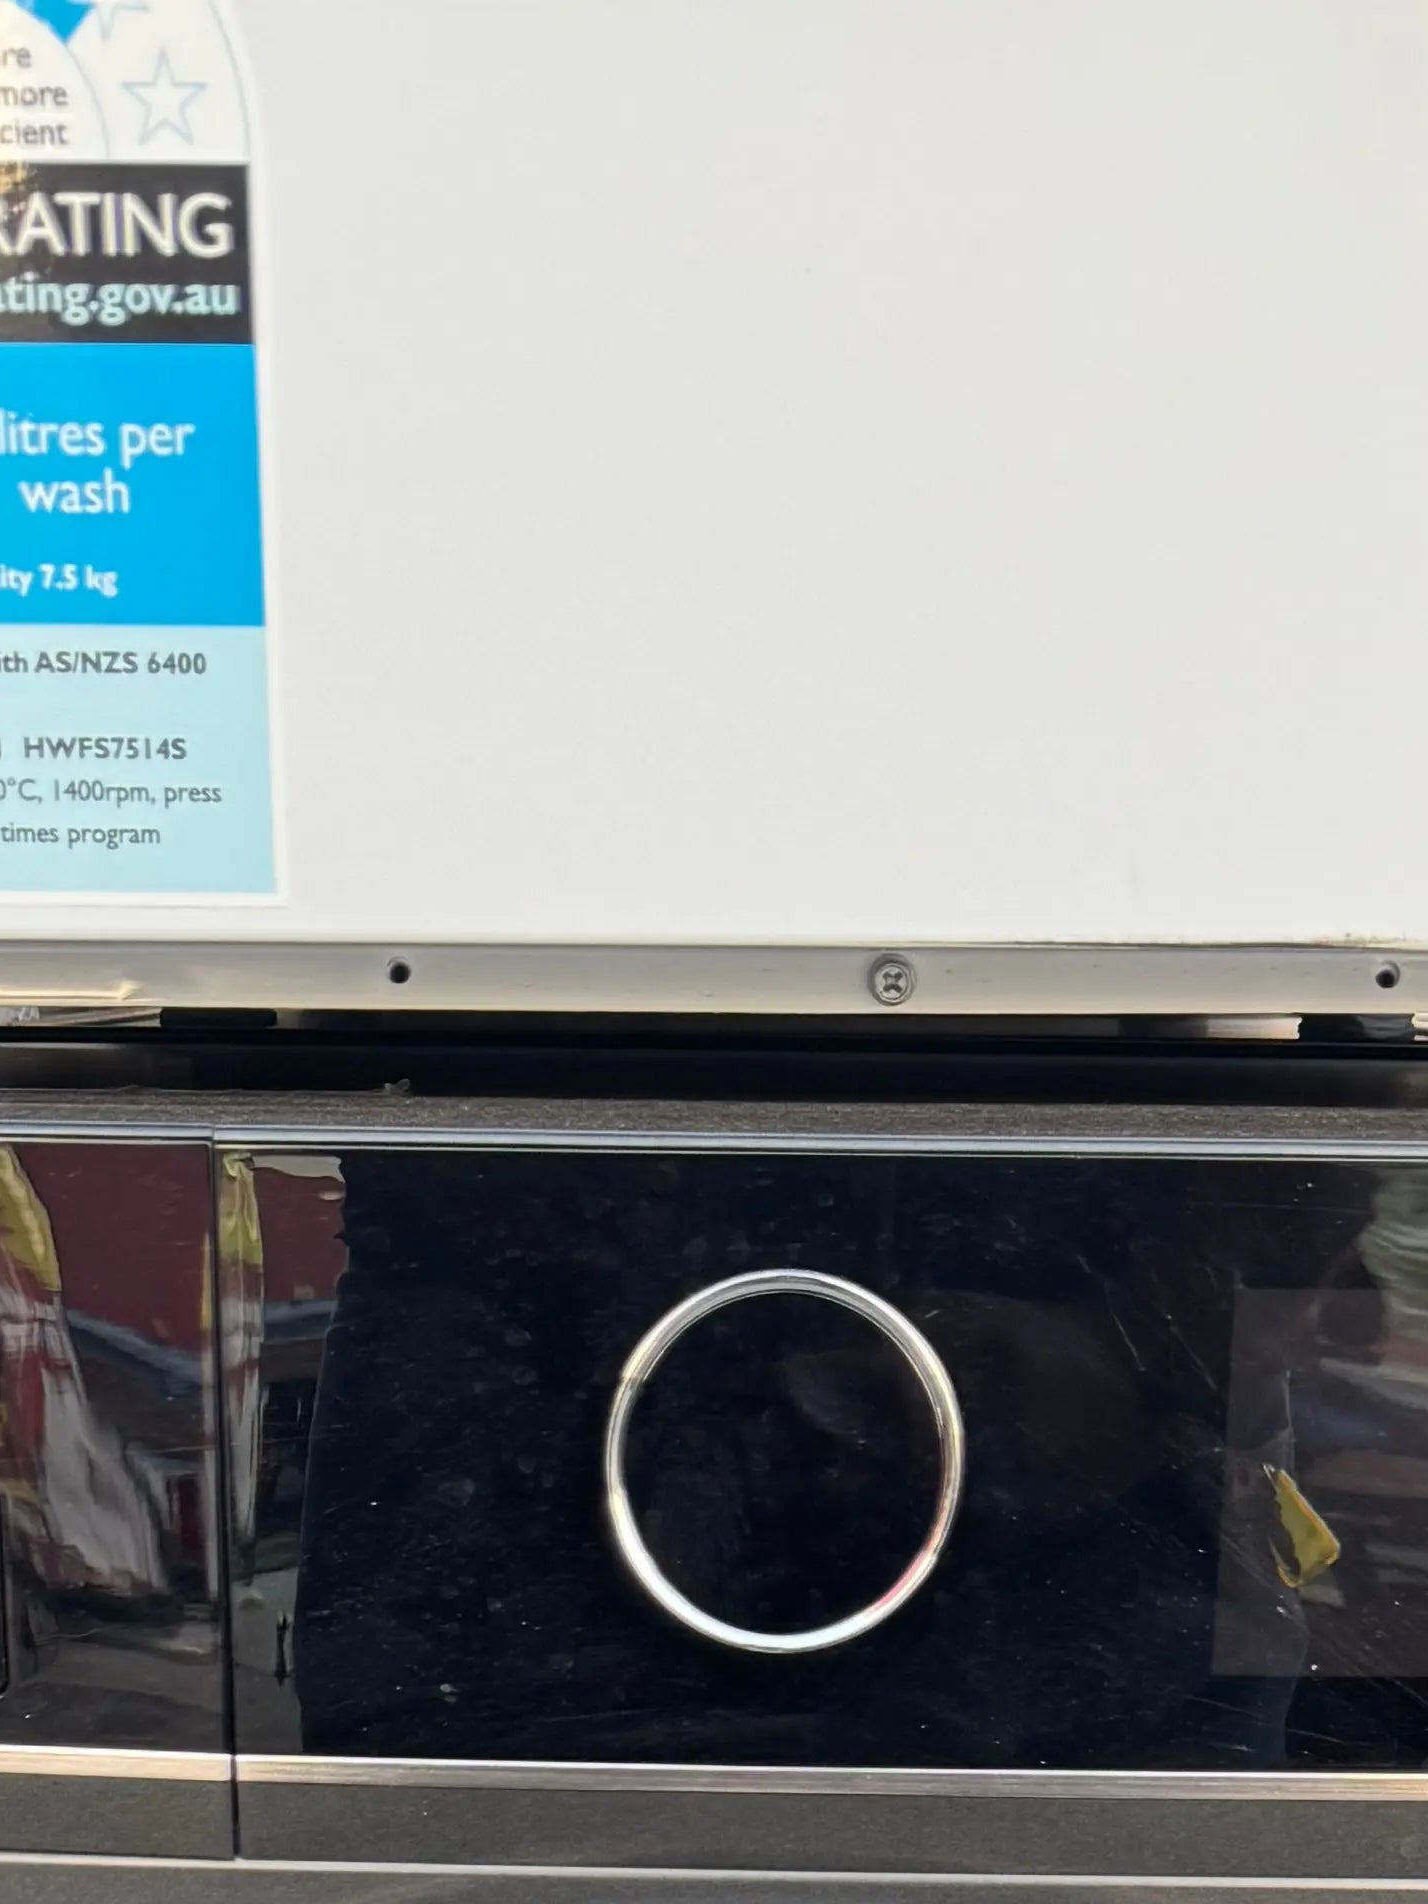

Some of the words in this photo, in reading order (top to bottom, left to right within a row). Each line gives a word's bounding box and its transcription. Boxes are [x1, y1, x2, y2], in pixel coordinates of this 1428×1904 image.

[118, 421, 196, 469] per
[18, 467, 131, 514] wash
[39, 564, 78, 590] 7.5
[85, 565, 119, 598] kg
[34, 651, 139, 676] AS/NZS
[146, 651, 208, 676] 6400
[23, 736, 188, 762] HWFS7514S
[53, 780, 157, 810] 1400rpm,
[164, 784, 224, 810] press
[0, 822, 61, 845] times
[67, 825, 162, 850] program
